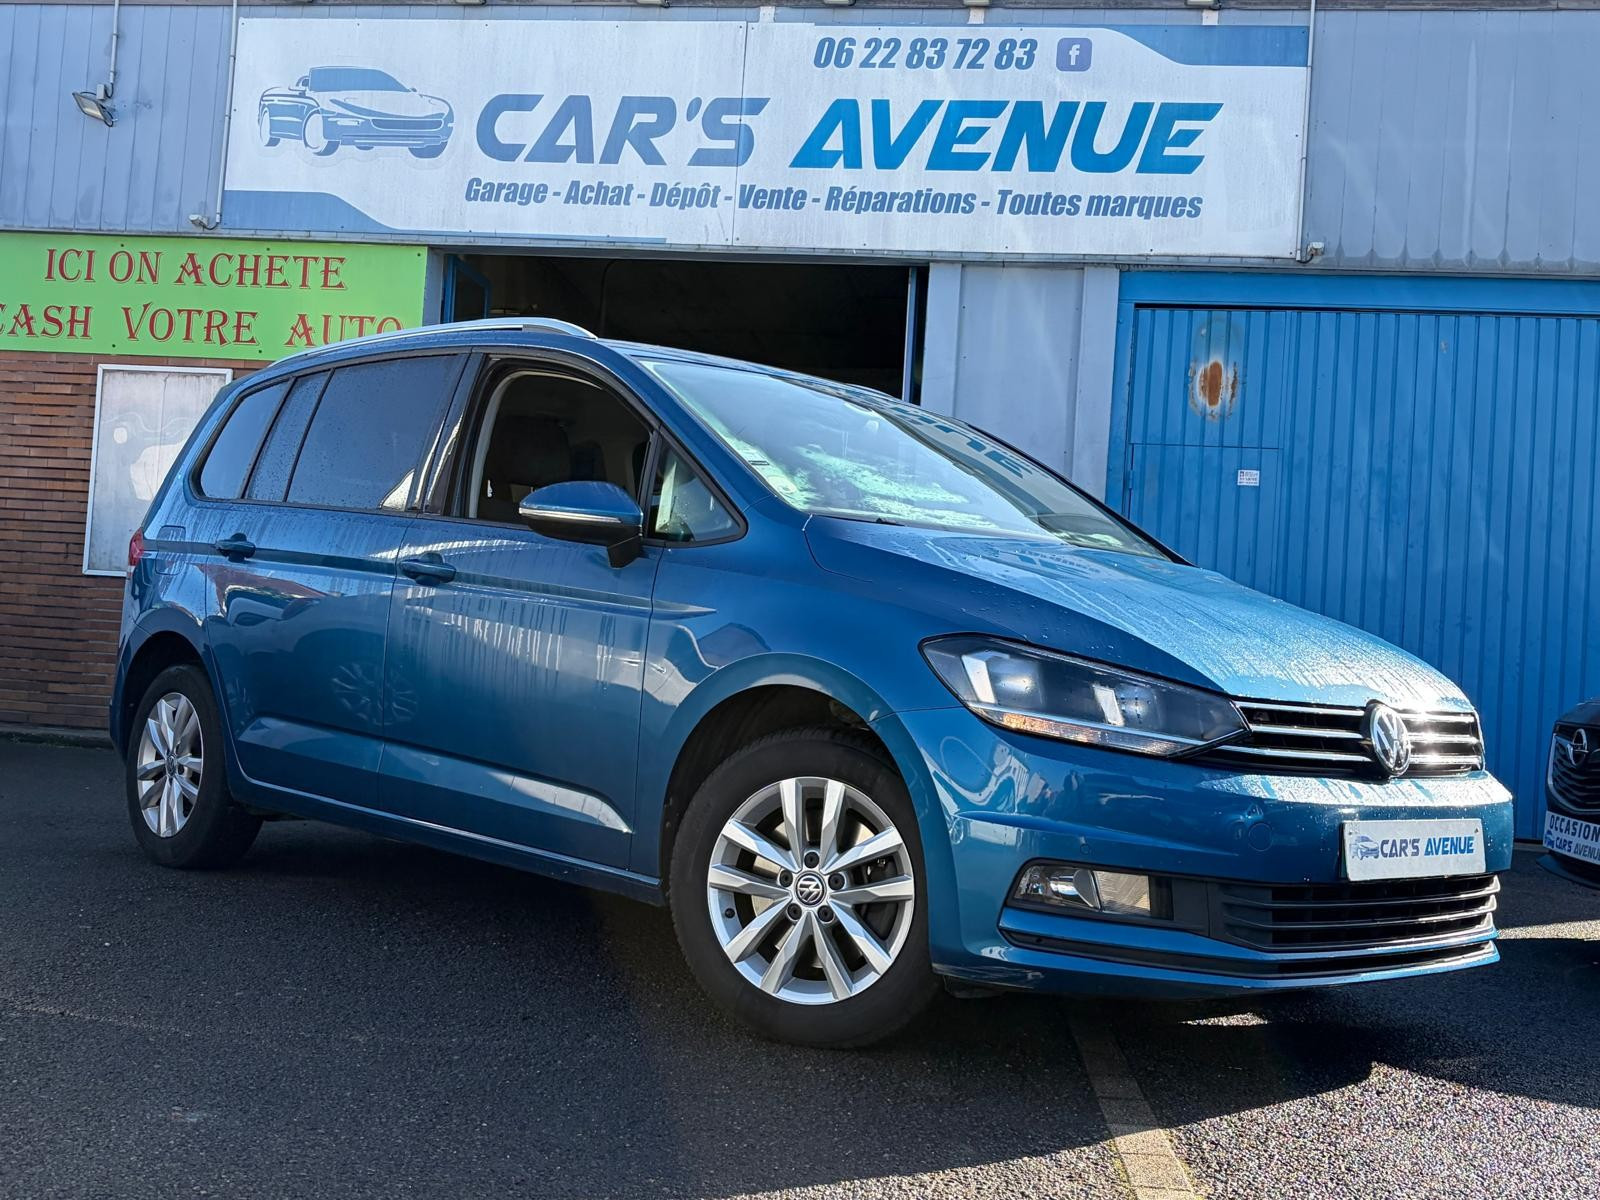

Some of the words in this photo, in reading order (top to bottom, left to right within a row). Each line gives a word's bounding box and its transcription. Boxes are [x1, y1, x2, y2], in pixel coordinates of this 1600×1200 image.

[813, 36, 857, 69] 06
[859, 37, 902, 69] 22
[904, 37, 949, 70] 83
[952, 37, 991, 70] 72
[993, 38, 1039, 71] 83
[475, 93, 771, 168] CAR'S
[788, 98, 1225, 175] AVENUE
[464, 177, 549, 207] Garage
[563, 180, 635, 207] Achat
[649, 181, 722, 211] Dépôt
[738, 183, 808, 211] Vente
[823, 185, 977, 215] Réparations
[996, 189, 1083, 217] Toutes
[1084, 194, 1204, 221] marques
[46, 249, 95, 282] ICI
[109, 250, 162, 284] ON
[176, 252, 347, 290] ACHETE
[122, 302, 259, 346] VOTRE
[1380, 838, 1421, 858] CAR'S
[1423, 836, 1475, 856] AVENUE
